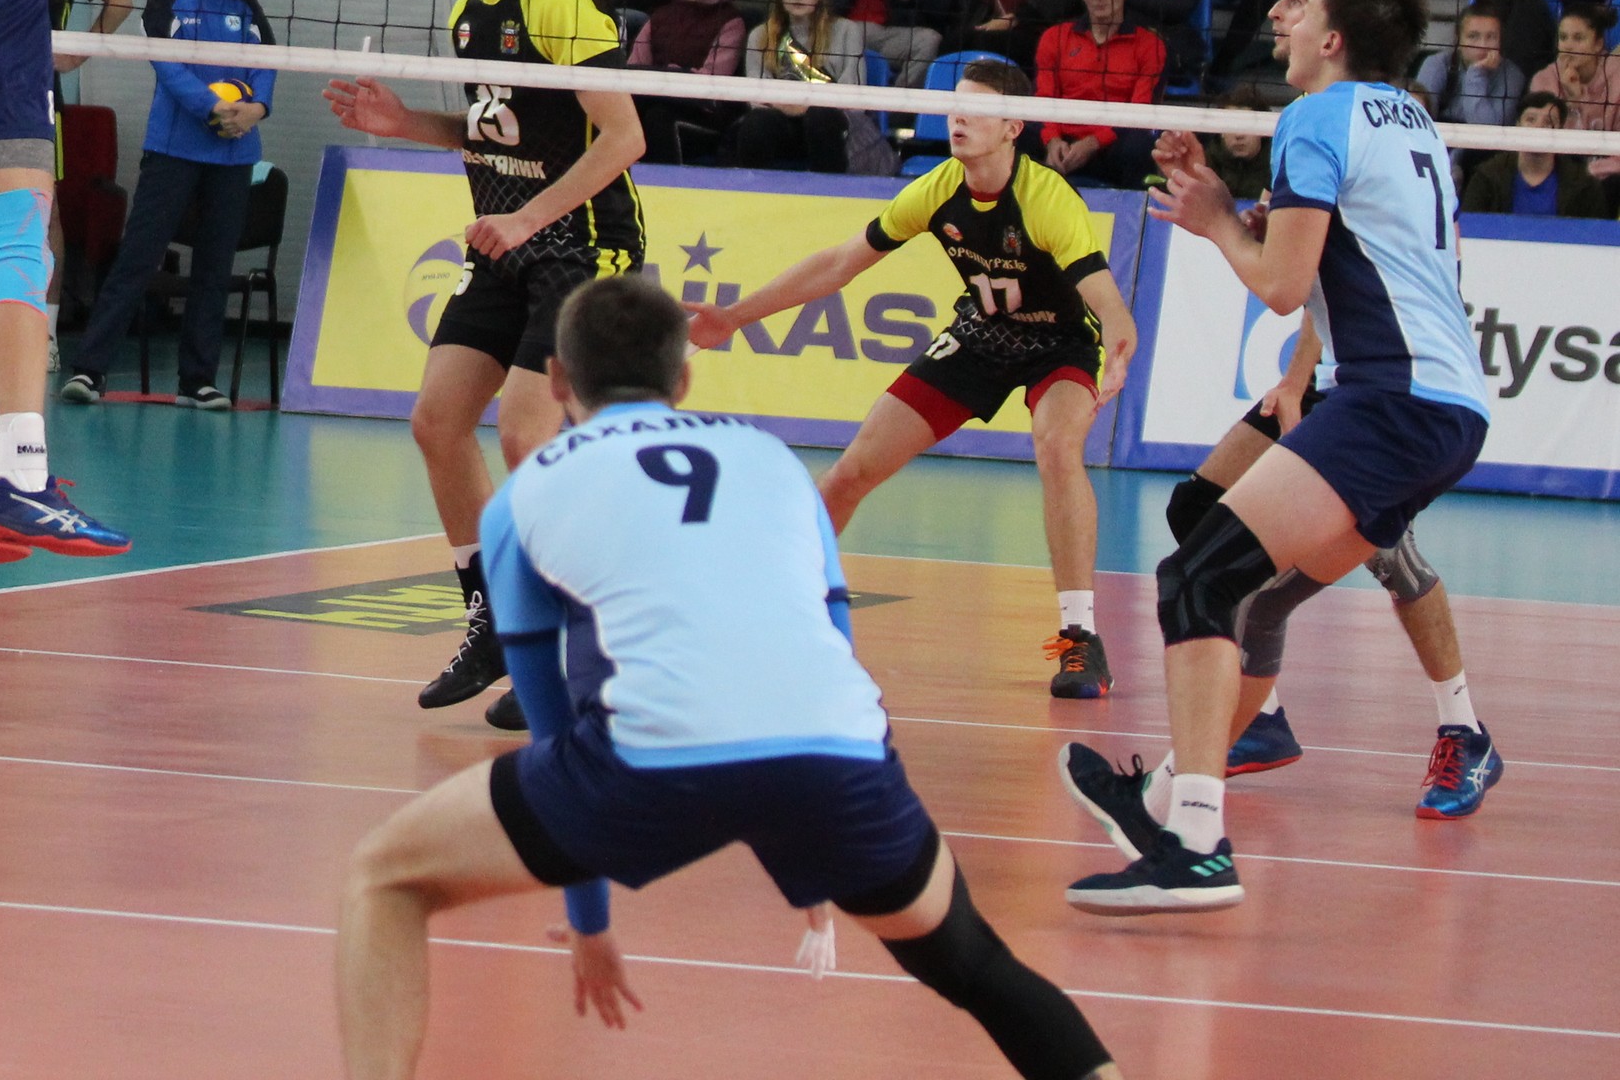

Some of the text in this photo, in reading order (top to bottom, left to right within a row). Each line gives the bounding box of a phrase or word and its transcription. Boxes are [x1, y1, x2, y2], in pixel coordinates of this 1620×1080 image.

[1410, 150, 1446, 249] 7
[969, 272, 1023, 316] 17
[1465, 303, 1620, 398] tys
[636, 443, 720, 524] 9
